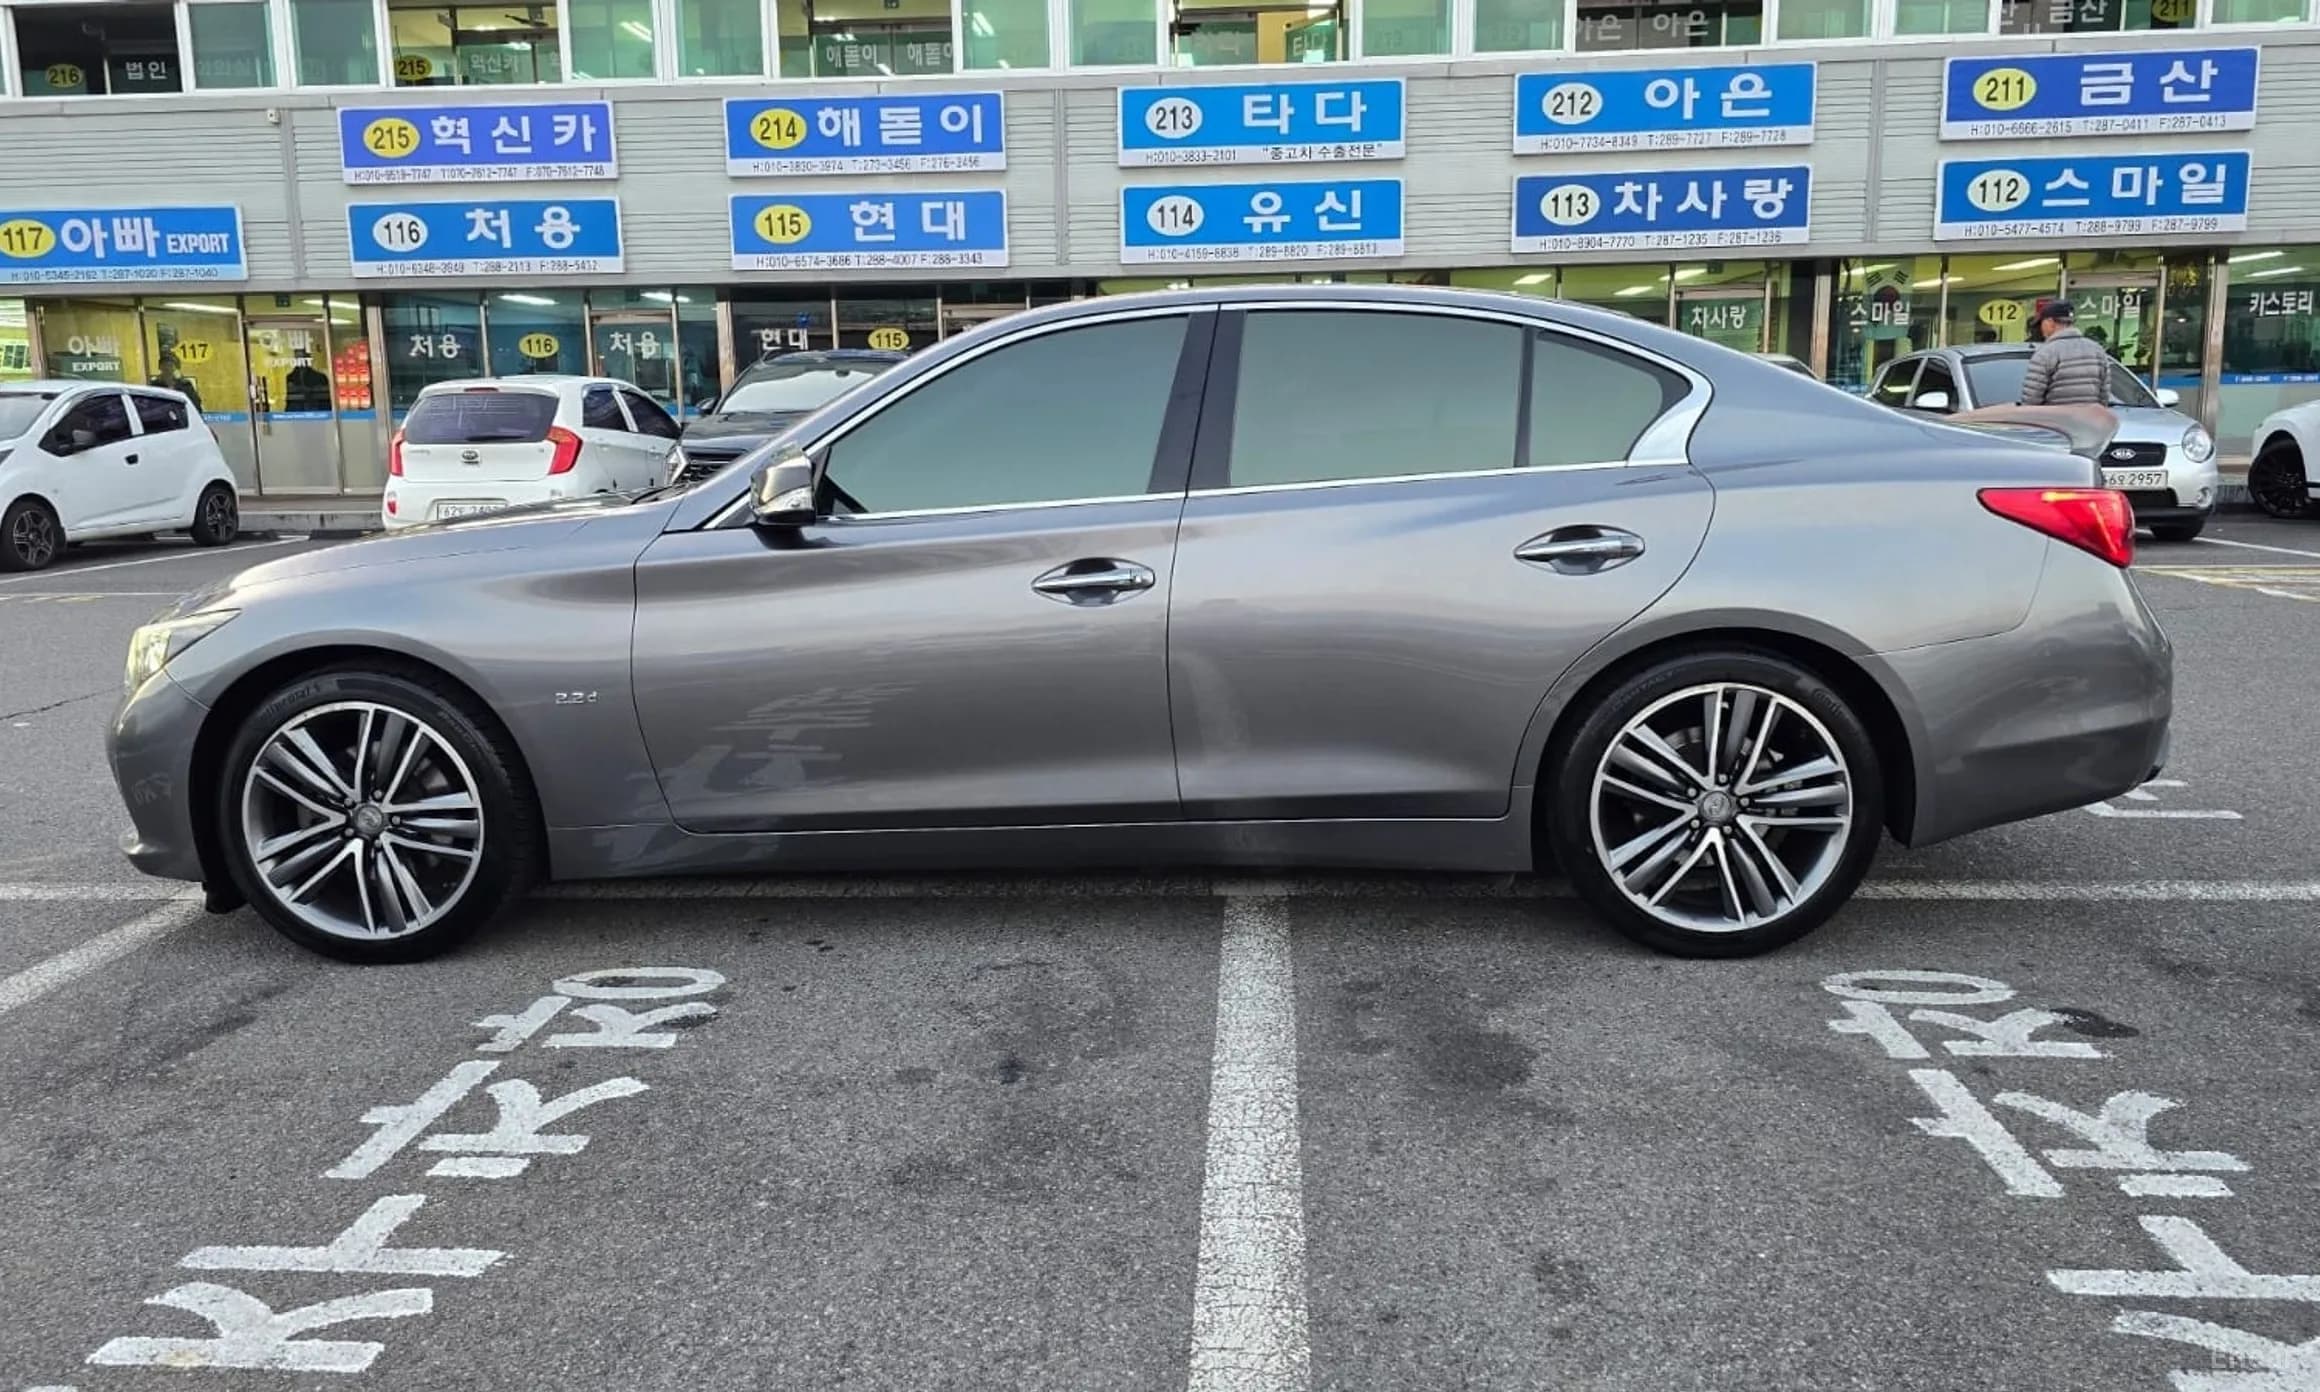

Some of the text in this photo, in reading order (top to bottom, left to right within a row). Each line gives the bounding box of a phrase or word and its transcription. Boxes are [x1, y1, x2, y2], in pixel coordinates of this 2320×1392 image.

[1653, 10, 1709, 37] 아은
[49, 70, 79, 84] 216
[126, 61, 168, 80] 법인
[399, 61, 426, 76] 215
[1986, 59, 2218, 107] 211 금산
[1552, 73, 1772, 120] 212 아은
[1155, 91, 1367, 135] 213 타다
[372, 114, 596, 155] 215 혁신카
[760, 117, 797, 140] 214
[1979, 162, 2226, 207] 112 스마일
[1157, 190, 1362, 233] 114 유신
[1551, 178, 1793, 221] 113 차사랑
[384, 206, 581, 249] 116 처용
[764, 200, 966, 243] 115 현대
[3, 217, 230, 259] 117 아빠 EXPORT
[1849, 301, 1910, 326] 스마일
[1987, 305, 2017, 320] 112
[2080, 292, 2141, 320] 스마일
[2249, 290, 2313, 316] 카스토리
[1691, 305, 1747, 329] 차사랑
[180, 343, 208, 359] 117
[409, 333, 461, 358] 처용
[526, 338, 553, 353] 116
[610, 330, 660, 358] 처용
[760, 327, 809, 350] 현대
[875, 332, 902, 348] 115
[72, 361, 120, 372] EXPORT
[2128, 473, 2161, 486] 2957
